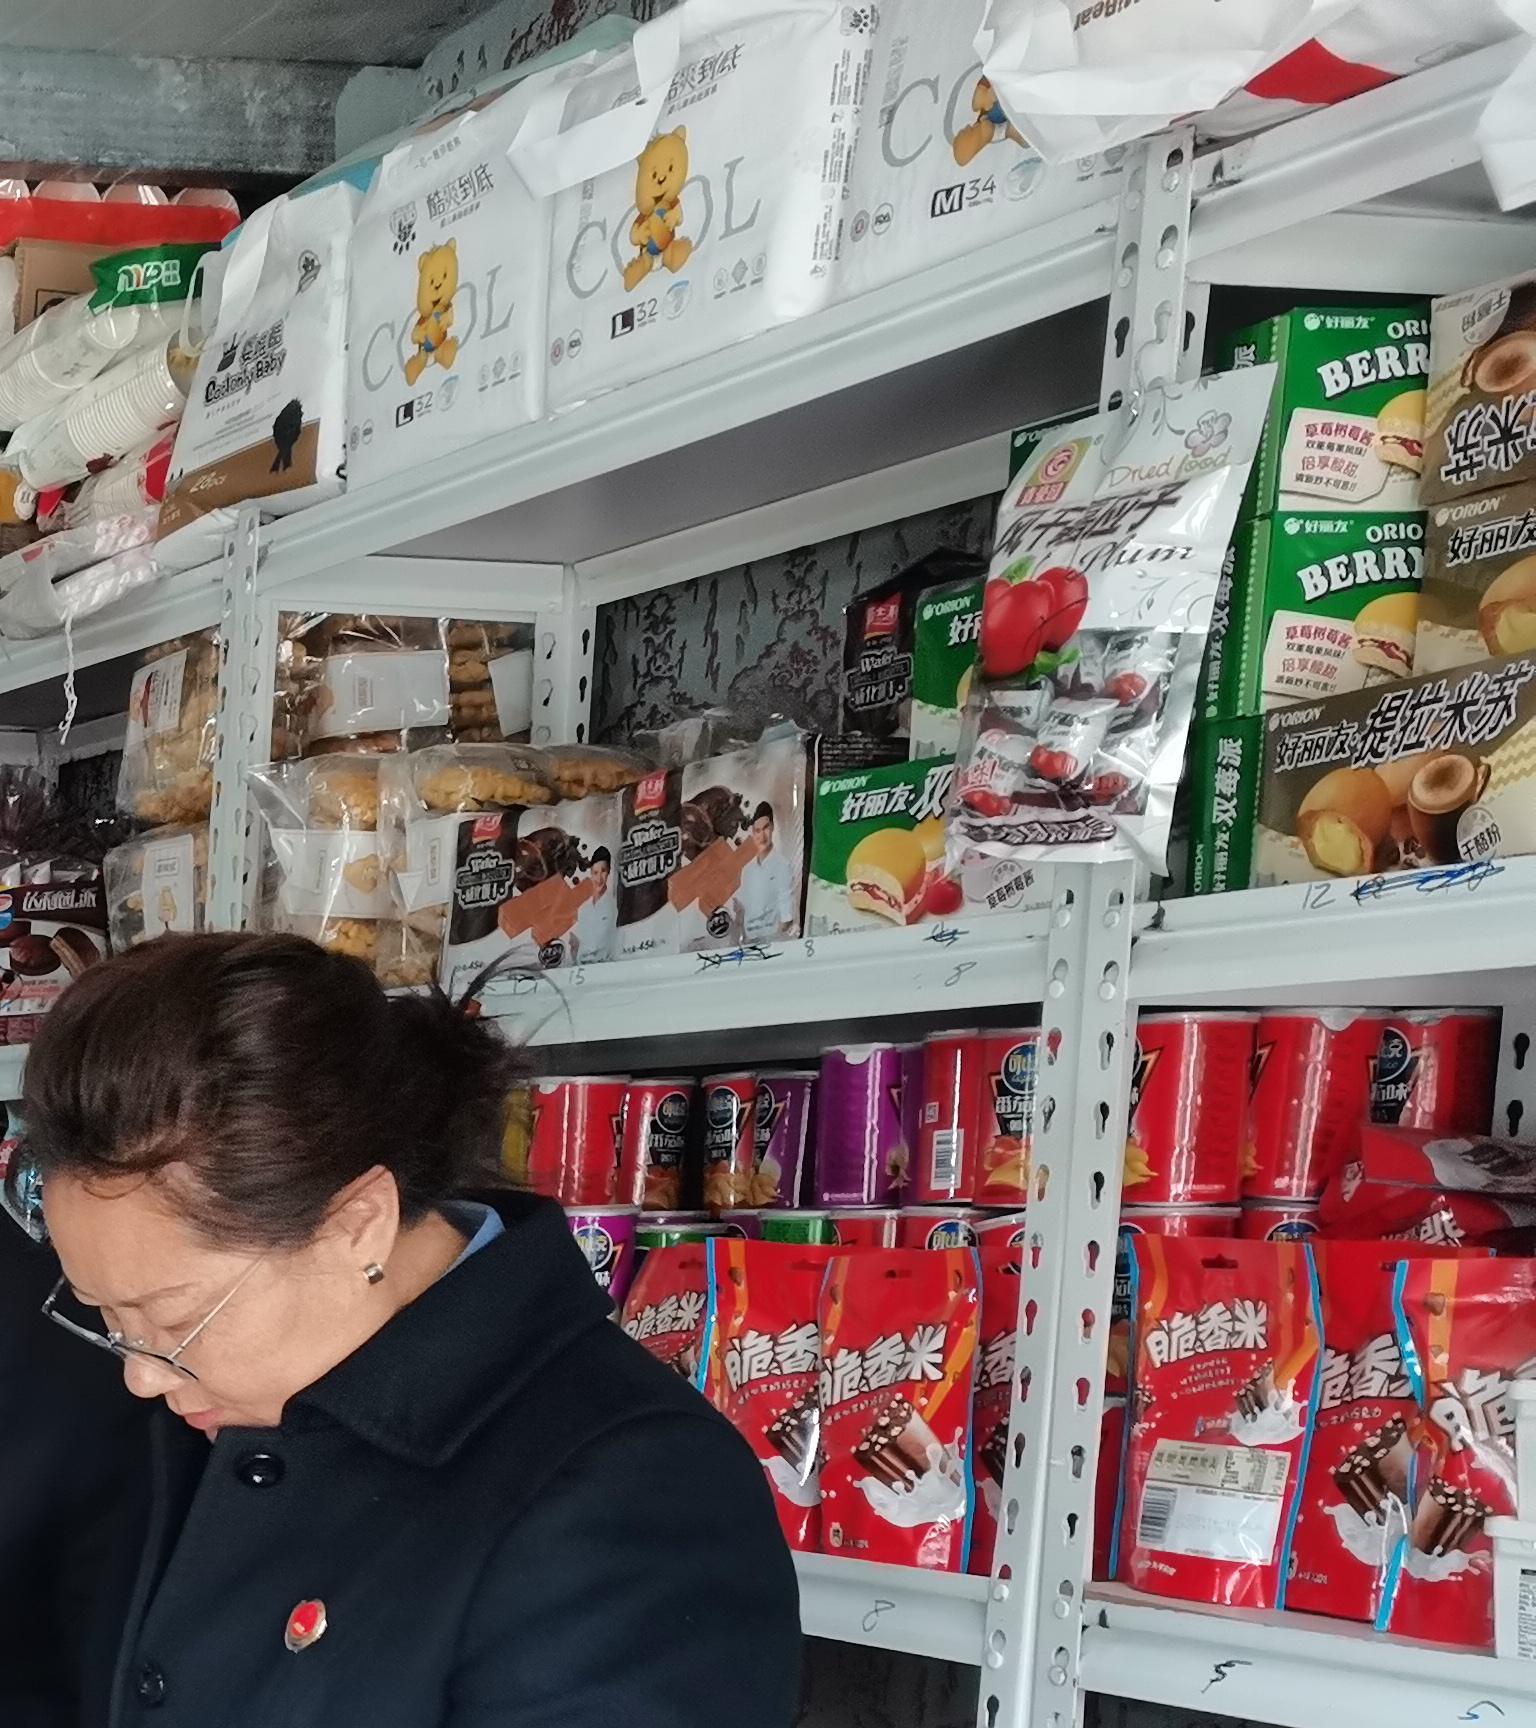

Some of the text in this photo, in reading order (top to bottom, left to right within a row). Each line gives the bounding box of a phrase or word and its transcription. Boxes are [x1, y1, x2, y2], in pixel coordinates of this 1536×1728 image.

[636, 298, 658, 322] 32
[1106, 456, 1171, 488] Dried
[1079, 534, 1196, 574] Plum
[1145, 1297, 1270, 1368] 脆香米
[821, 1324, 947, 1408] 脆香米
